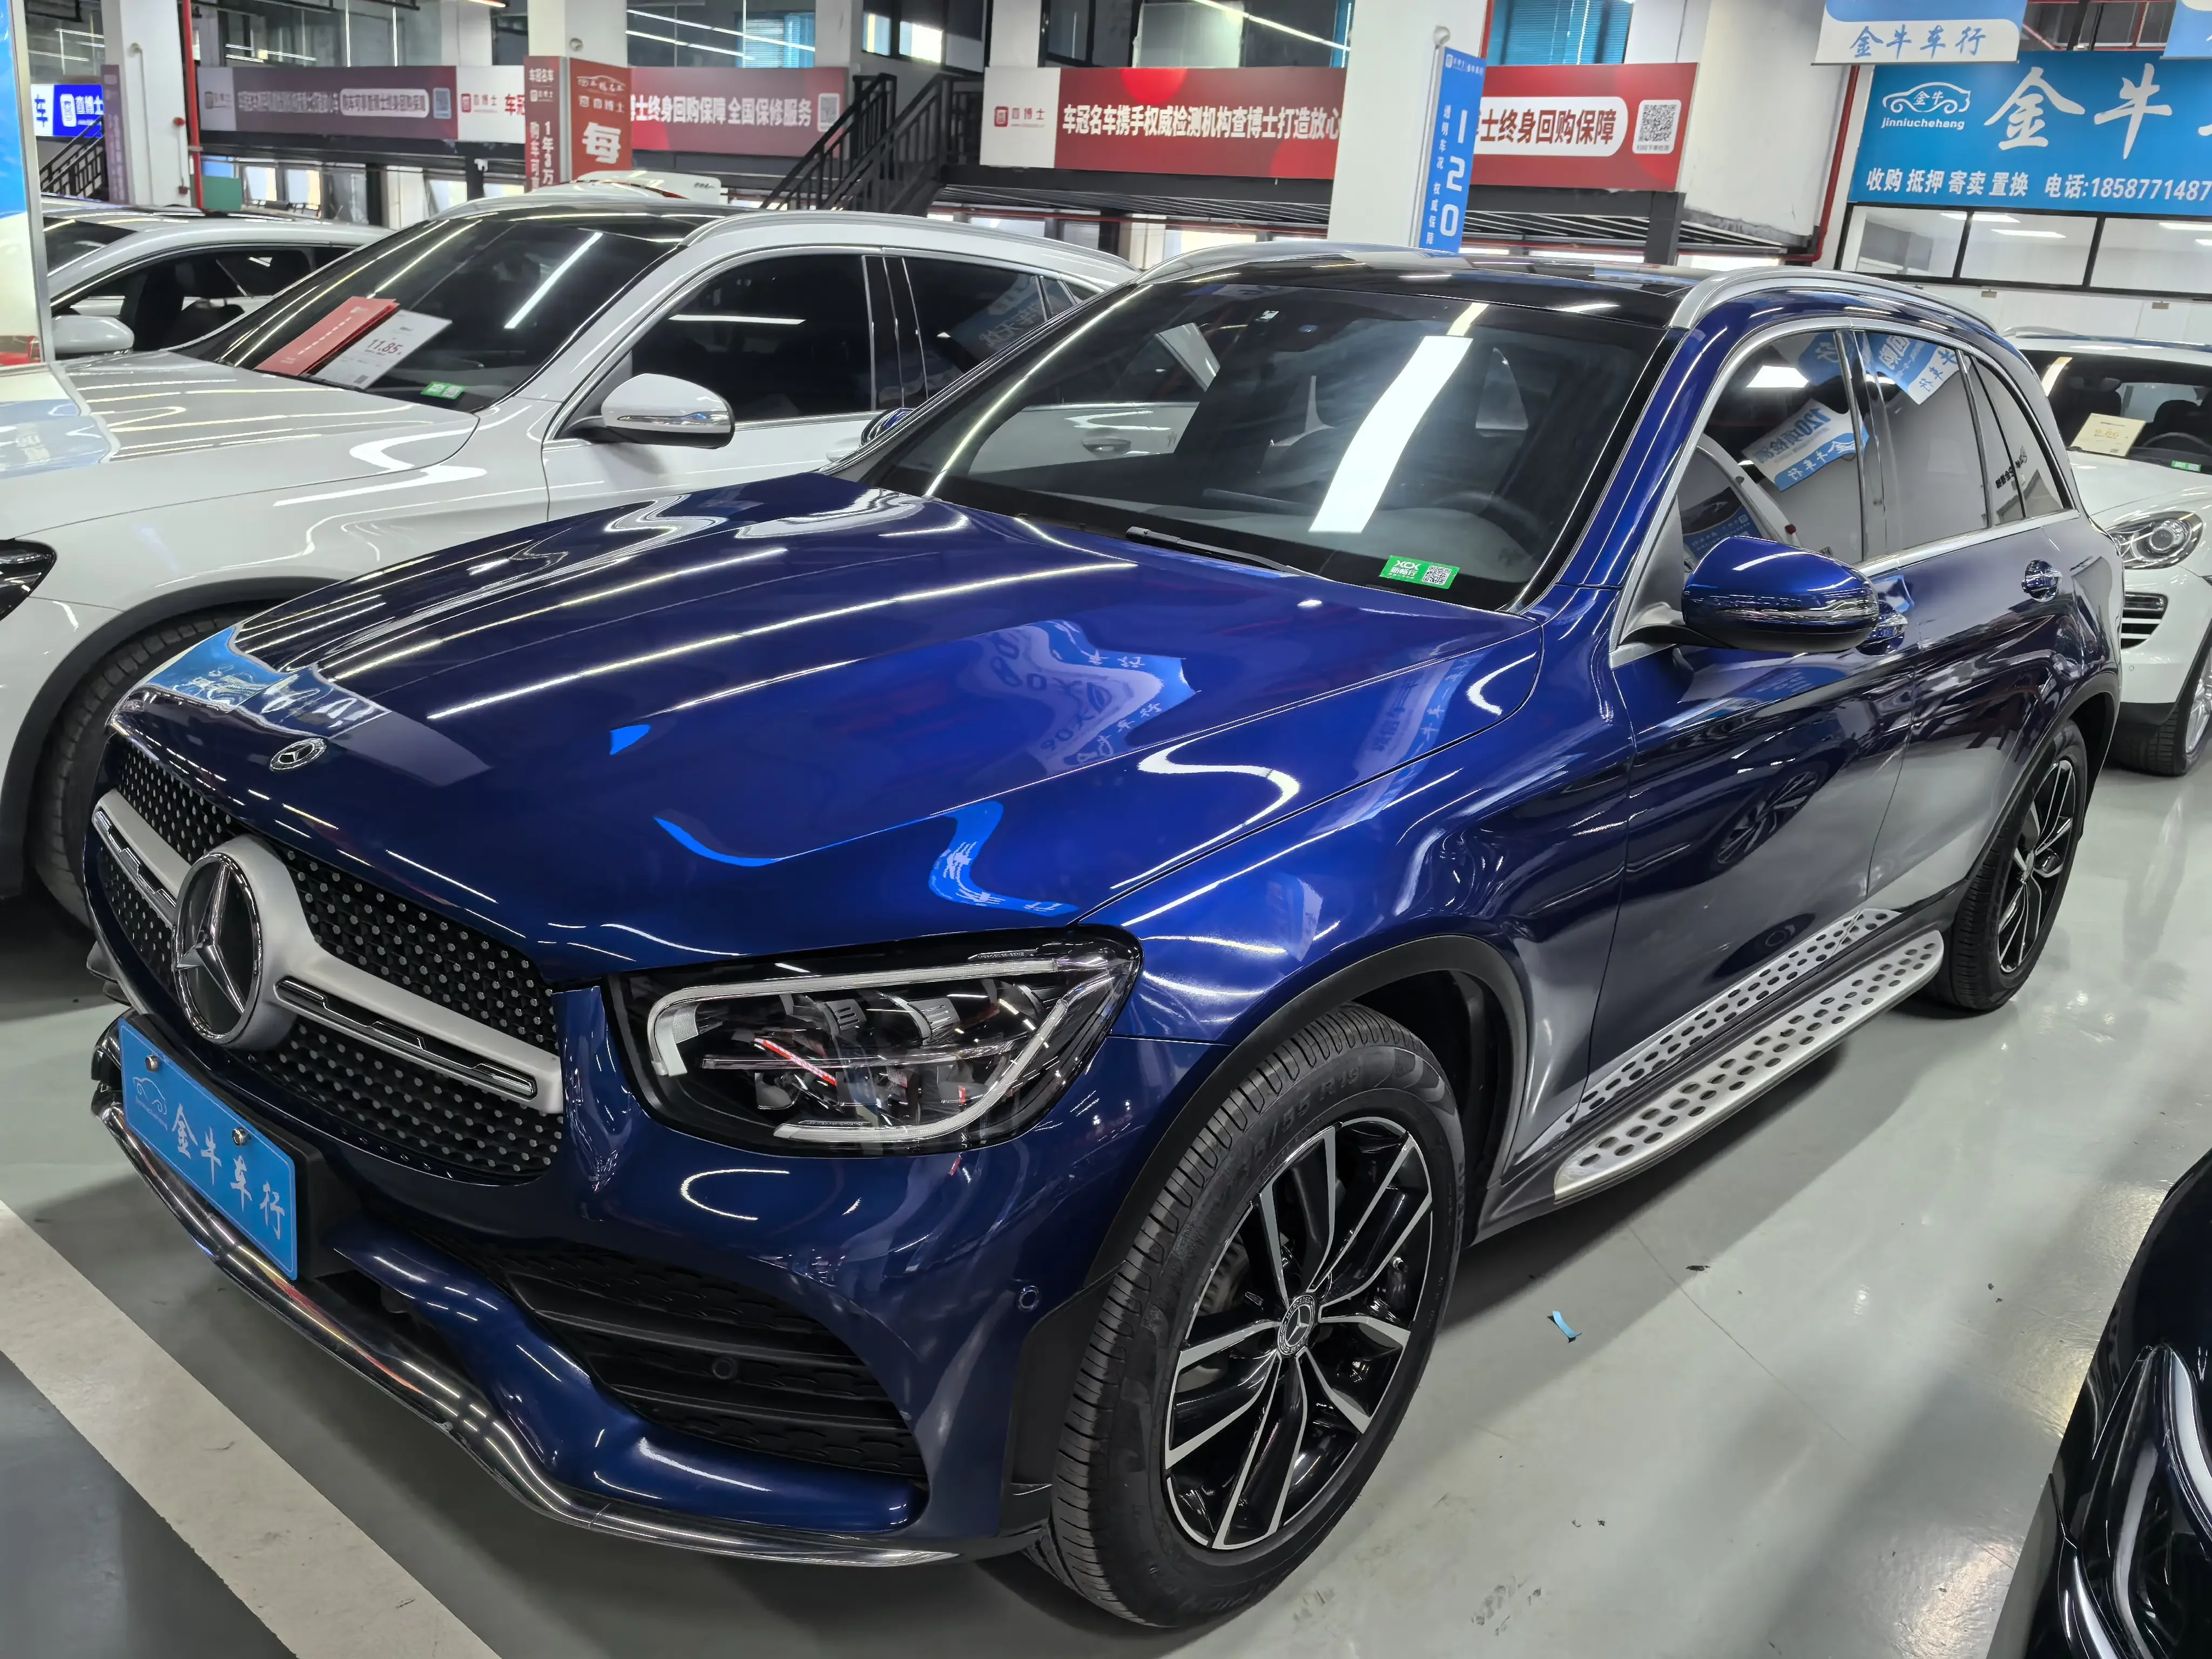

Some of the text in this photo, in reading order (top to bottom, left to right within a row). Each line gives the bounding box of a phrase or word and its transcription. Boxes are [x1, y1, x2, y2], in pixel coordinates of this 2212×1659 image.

[1850, 24, 1986, 60] 金牛车行
[631, 94, 812, 127] 士终身回购保障 全国保修服务
[1913, 91, 1945, 105] 金牛
[1984, 63, 2212, 160] 金牛
[582, 122, 621, 164] 每
[1476, 109, 1617, 145] 士终身回购保障
[1440, 109, 1468, 237] 120
[1866, 167, 1903, 192] 收购
[1906, 168, 1945, 194] 抵押
[1948, 170, 1986, 195] 寄卖
[1989, 172, 2028, 197] 置换
[172, 1103, 285, 1240] 金牛车行
